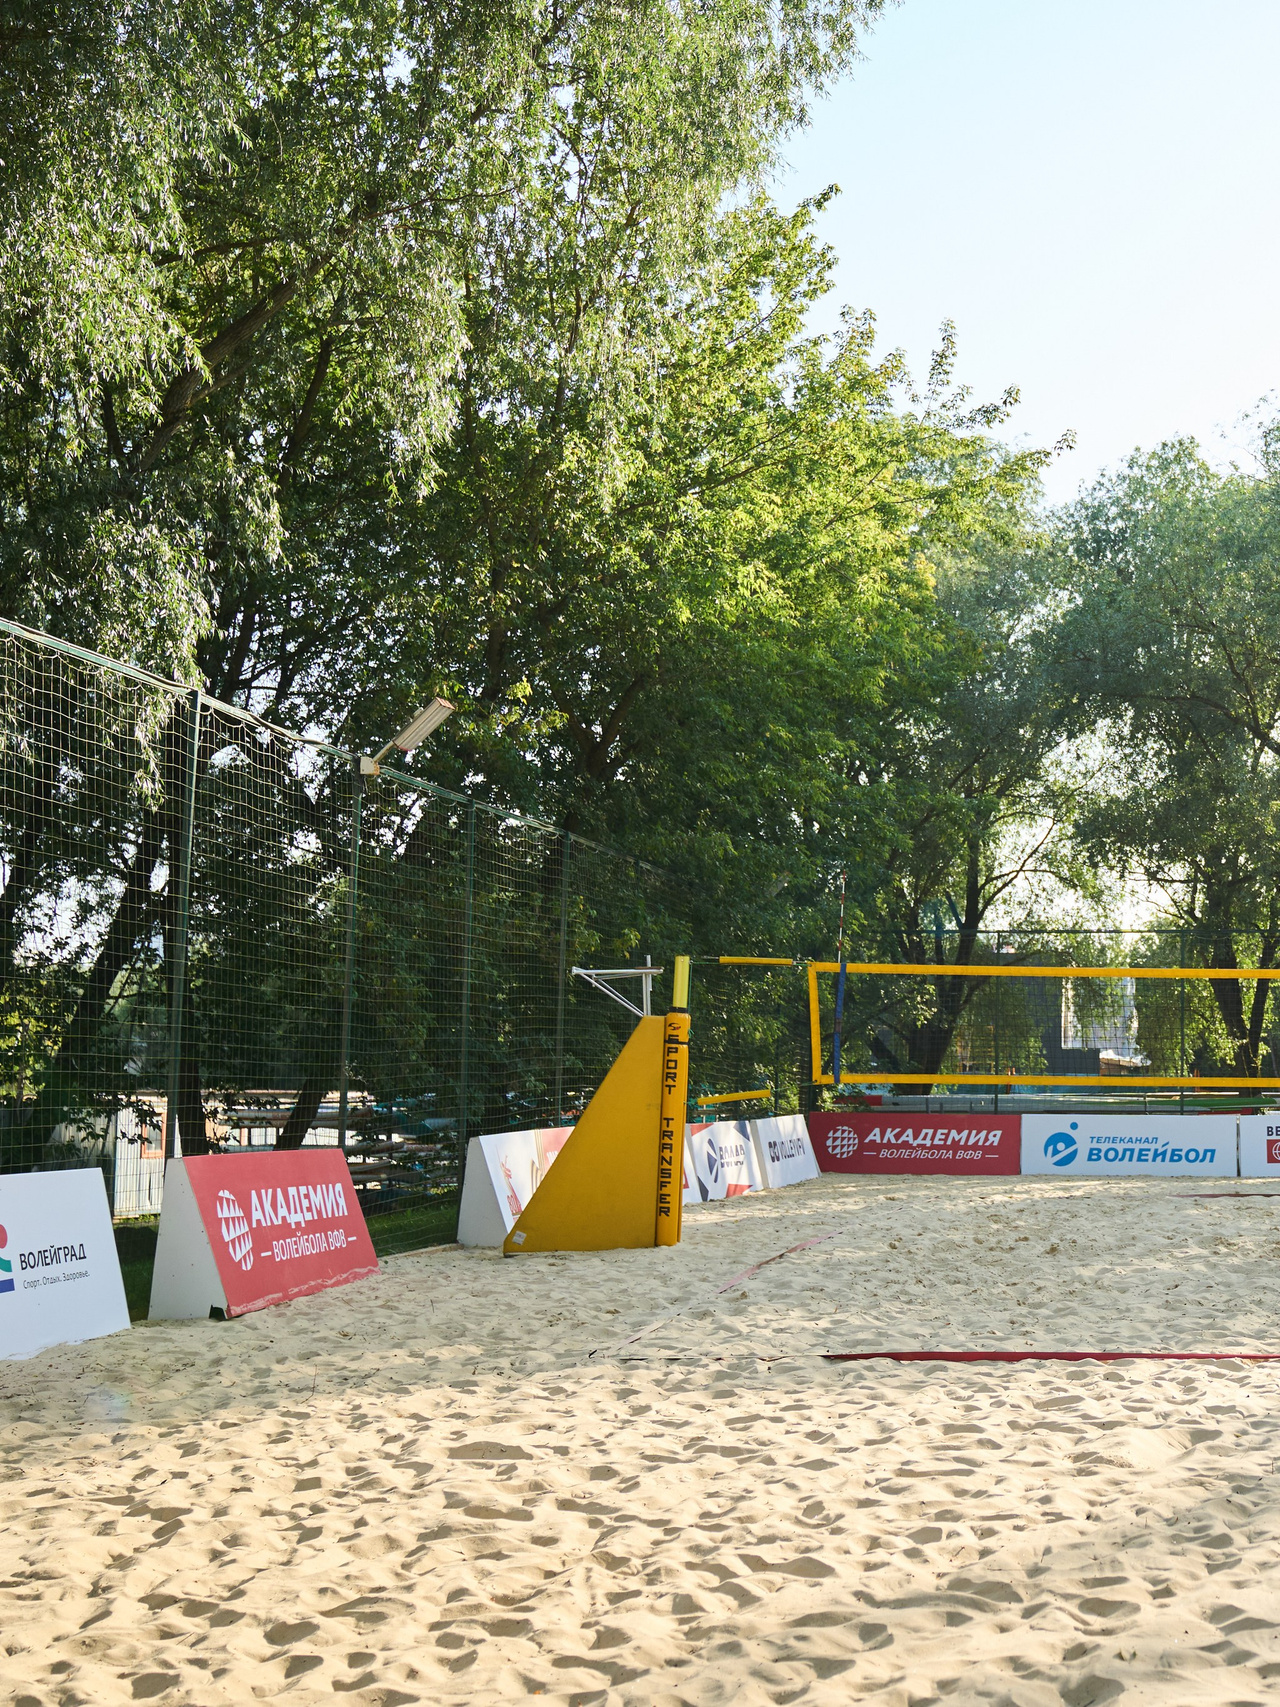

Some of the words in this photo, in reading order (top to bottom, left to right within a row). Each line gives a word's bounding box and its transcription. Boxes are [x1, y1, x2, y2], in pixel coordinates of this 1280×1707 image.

[864, 1127, 1002, 1147] АКАДЕМИЯ
[1089, 1136, 1158, 1145] ТЕЛЕКАНАЛ
[879, 1148, 953, 1159] ВОЛЕЙБОЛА
[955, 1150, 983, 1160] ВФВ
[1086, 1141, 1217, 1164] ВОЛЕЙБОЛ
[659, 1117, 674, 1217] TRANSFER
[251, 1182, 348, 1229] АКАДЕМИЯ
[19, 1243, 87, 1271] ВОЛЕЙГРАД
[272, 1231, 329, 1262] ВОЛЕЙБОЛА
[327, 1229, 347, 1250] ВФВ
